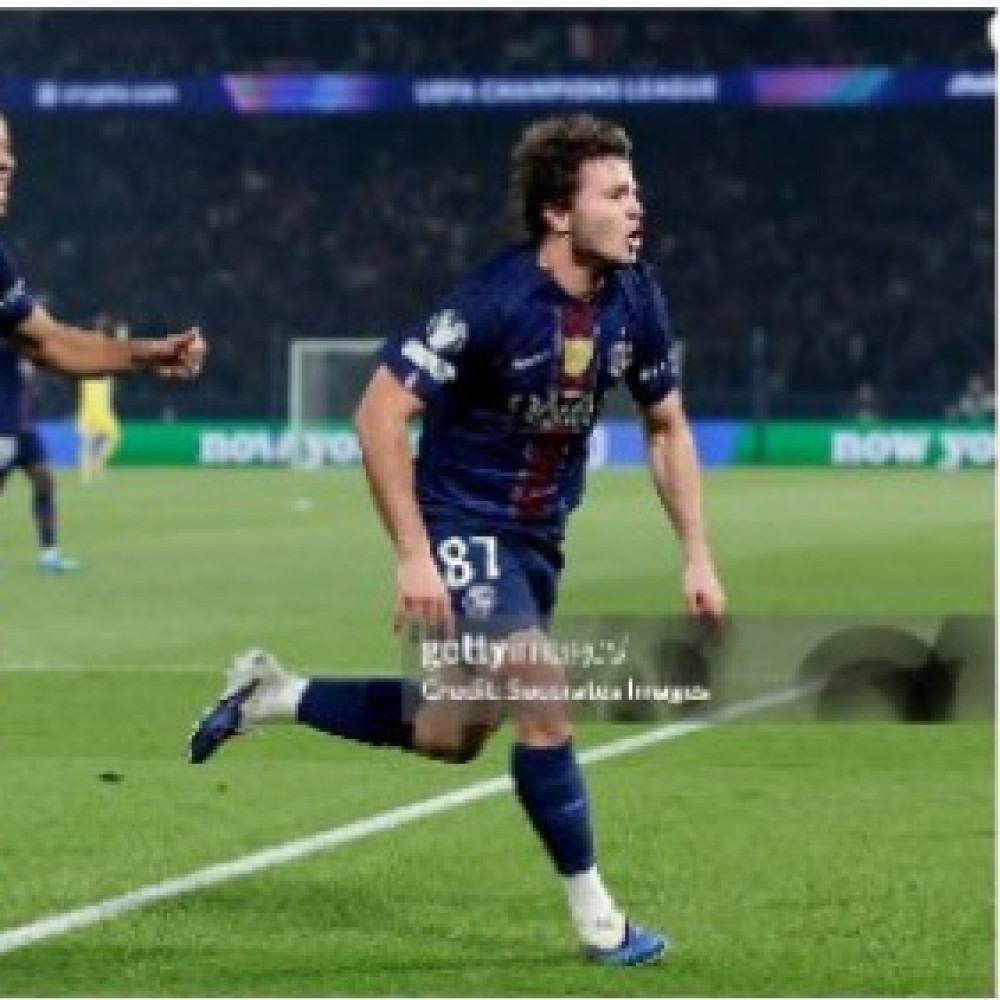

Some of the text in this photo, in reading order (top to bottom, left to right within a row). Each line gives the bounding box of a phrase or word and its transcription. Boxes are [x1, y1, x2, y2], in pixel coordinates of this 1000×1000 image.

[413, 76, 718, 105] UEFA CHAMPIONS LEAGUE
[831, 430, 928, 465] now
[437, 534, 500, 588] 87
